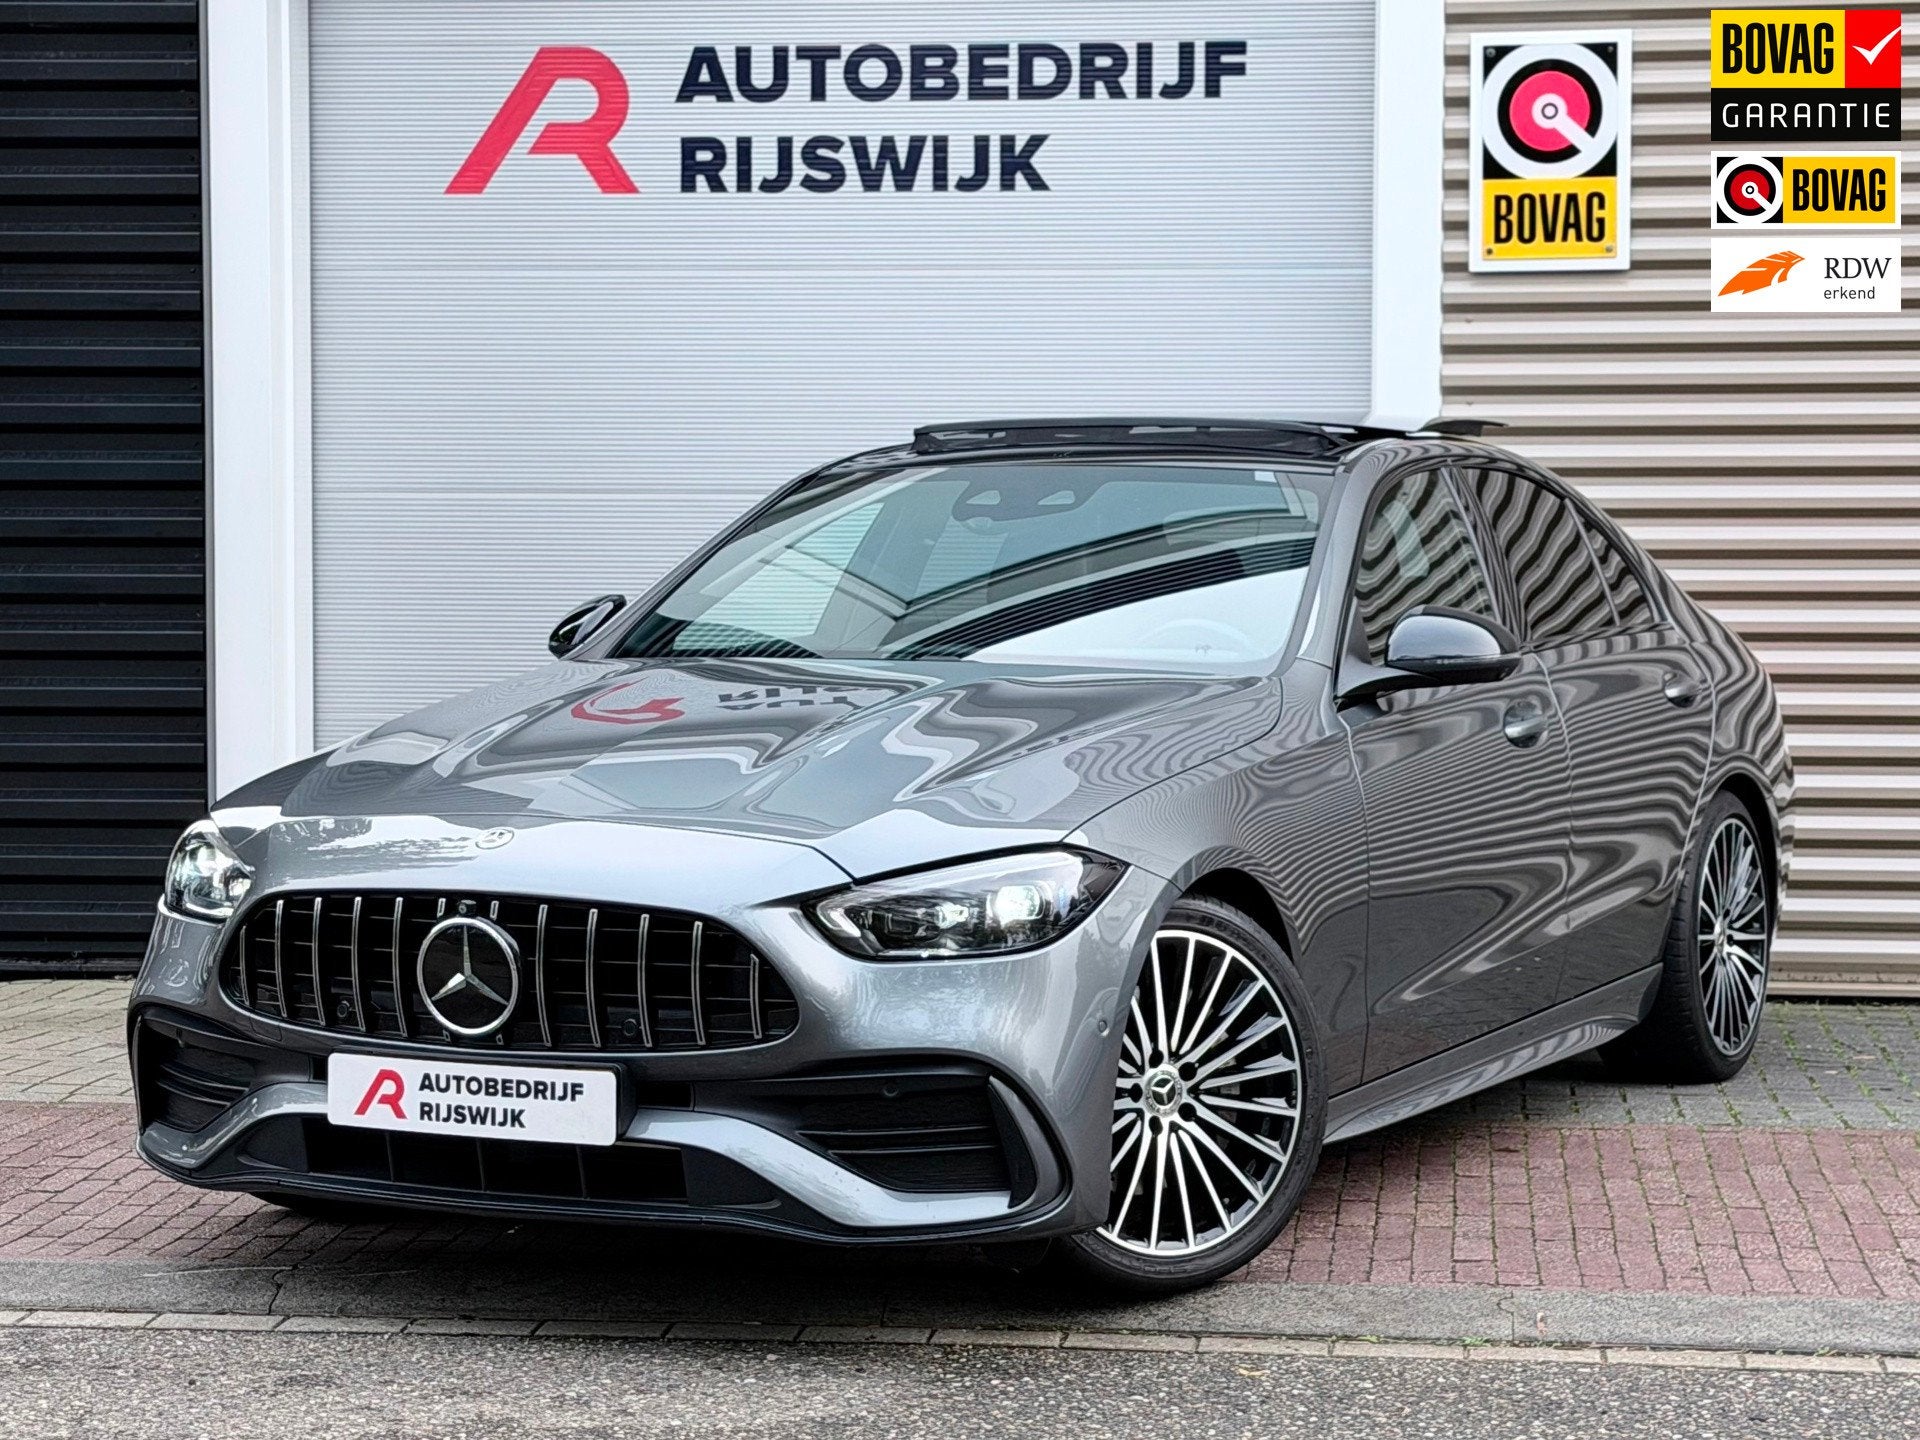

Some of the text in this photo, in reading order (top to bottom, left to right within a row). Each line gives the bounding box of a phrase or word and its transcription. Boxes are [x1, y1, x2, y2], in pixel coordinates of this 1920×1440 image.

[675, 41, 1247, 103] AUTOBEDRIJF
[680, 134, 1051, 193] RIJSWIJK
[1494, 192, 1606, 245] BOVAG
[418, 1072, 584, 1102] AUTOBEDRIJF
[419, 1102, 526, 1128] RIJSWIJK
